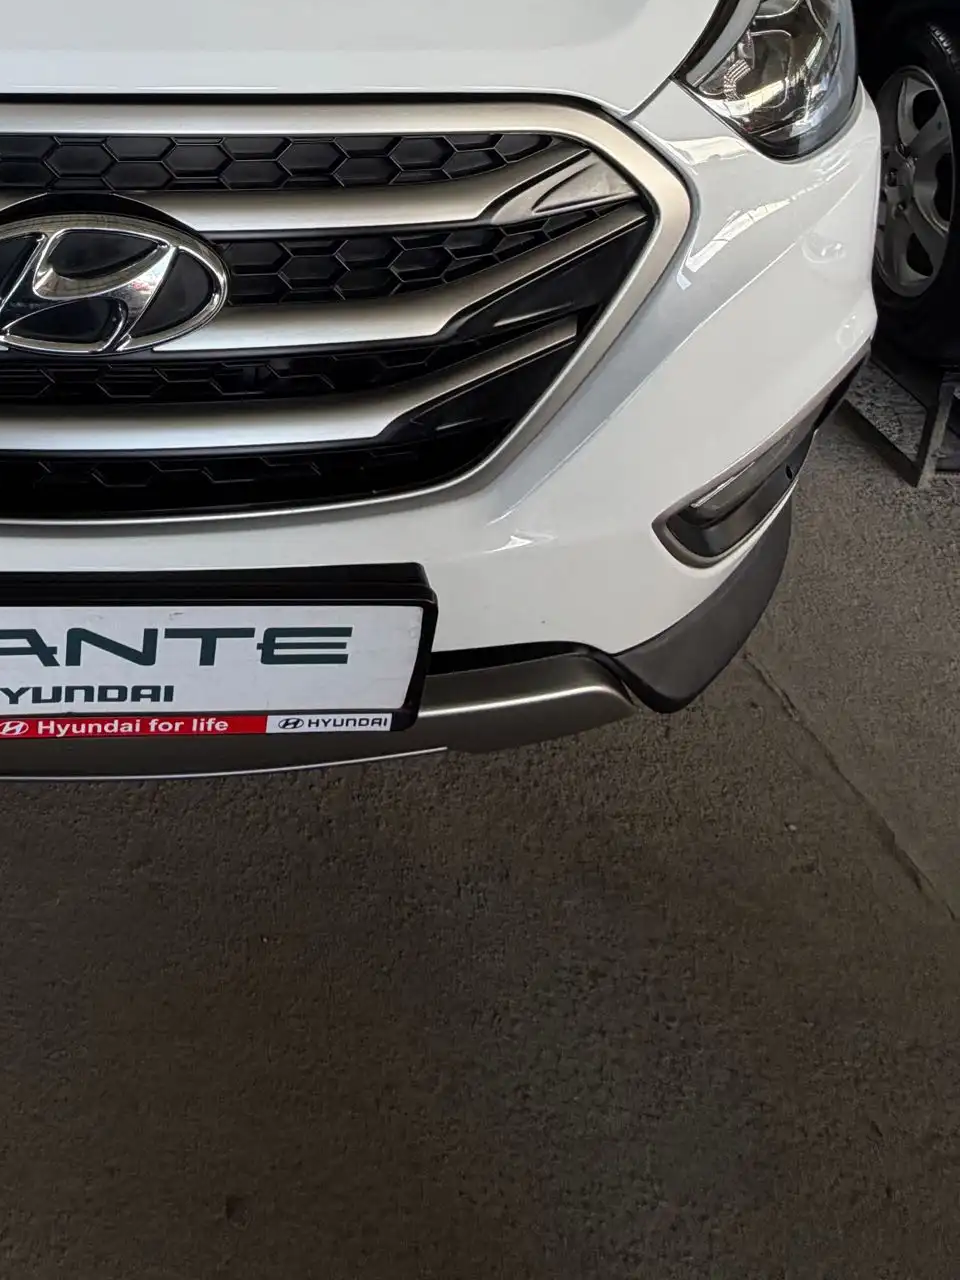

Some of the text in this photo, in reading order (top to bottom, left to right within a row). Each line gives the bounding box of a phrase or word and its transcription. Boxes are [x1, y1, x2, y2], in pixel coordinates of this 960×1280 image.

[37, 717, 229, 737] Hyundai for life
[307, 717, 388, 729] HYUNDAI
